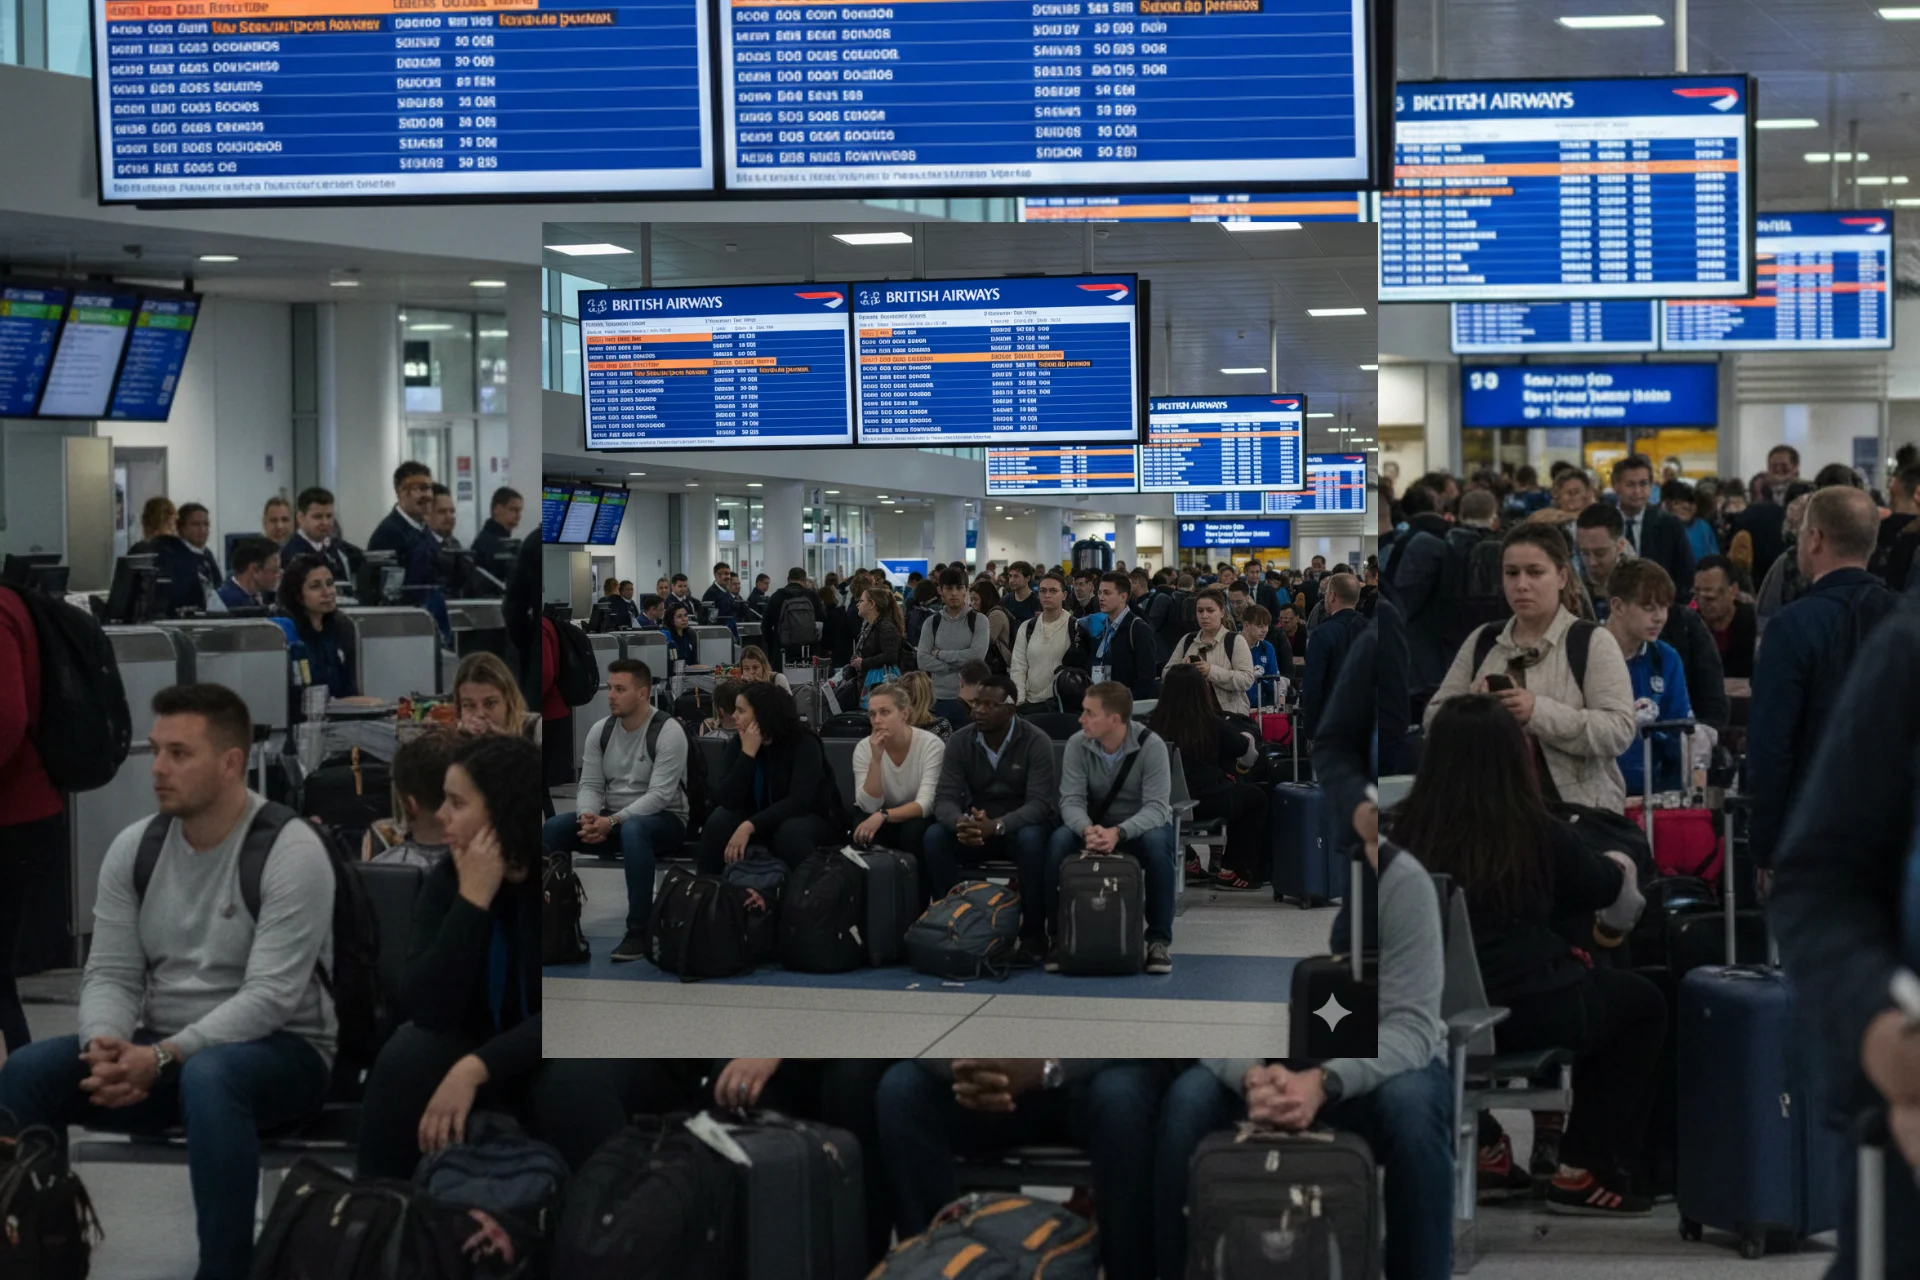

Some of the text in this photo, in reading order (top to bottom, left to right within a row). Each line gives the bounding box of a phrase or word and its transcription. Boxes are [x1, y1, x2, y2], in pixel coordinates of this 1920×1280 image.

[1490, 91, 1575, 110] AIRWAYS
[612, 296, 723, 311] BRITISH AIRWAYS
[886, 287, 1000, 304] BRITISH AIRWAYS
[1191, 401, 1228, 410] AIRWAYS
